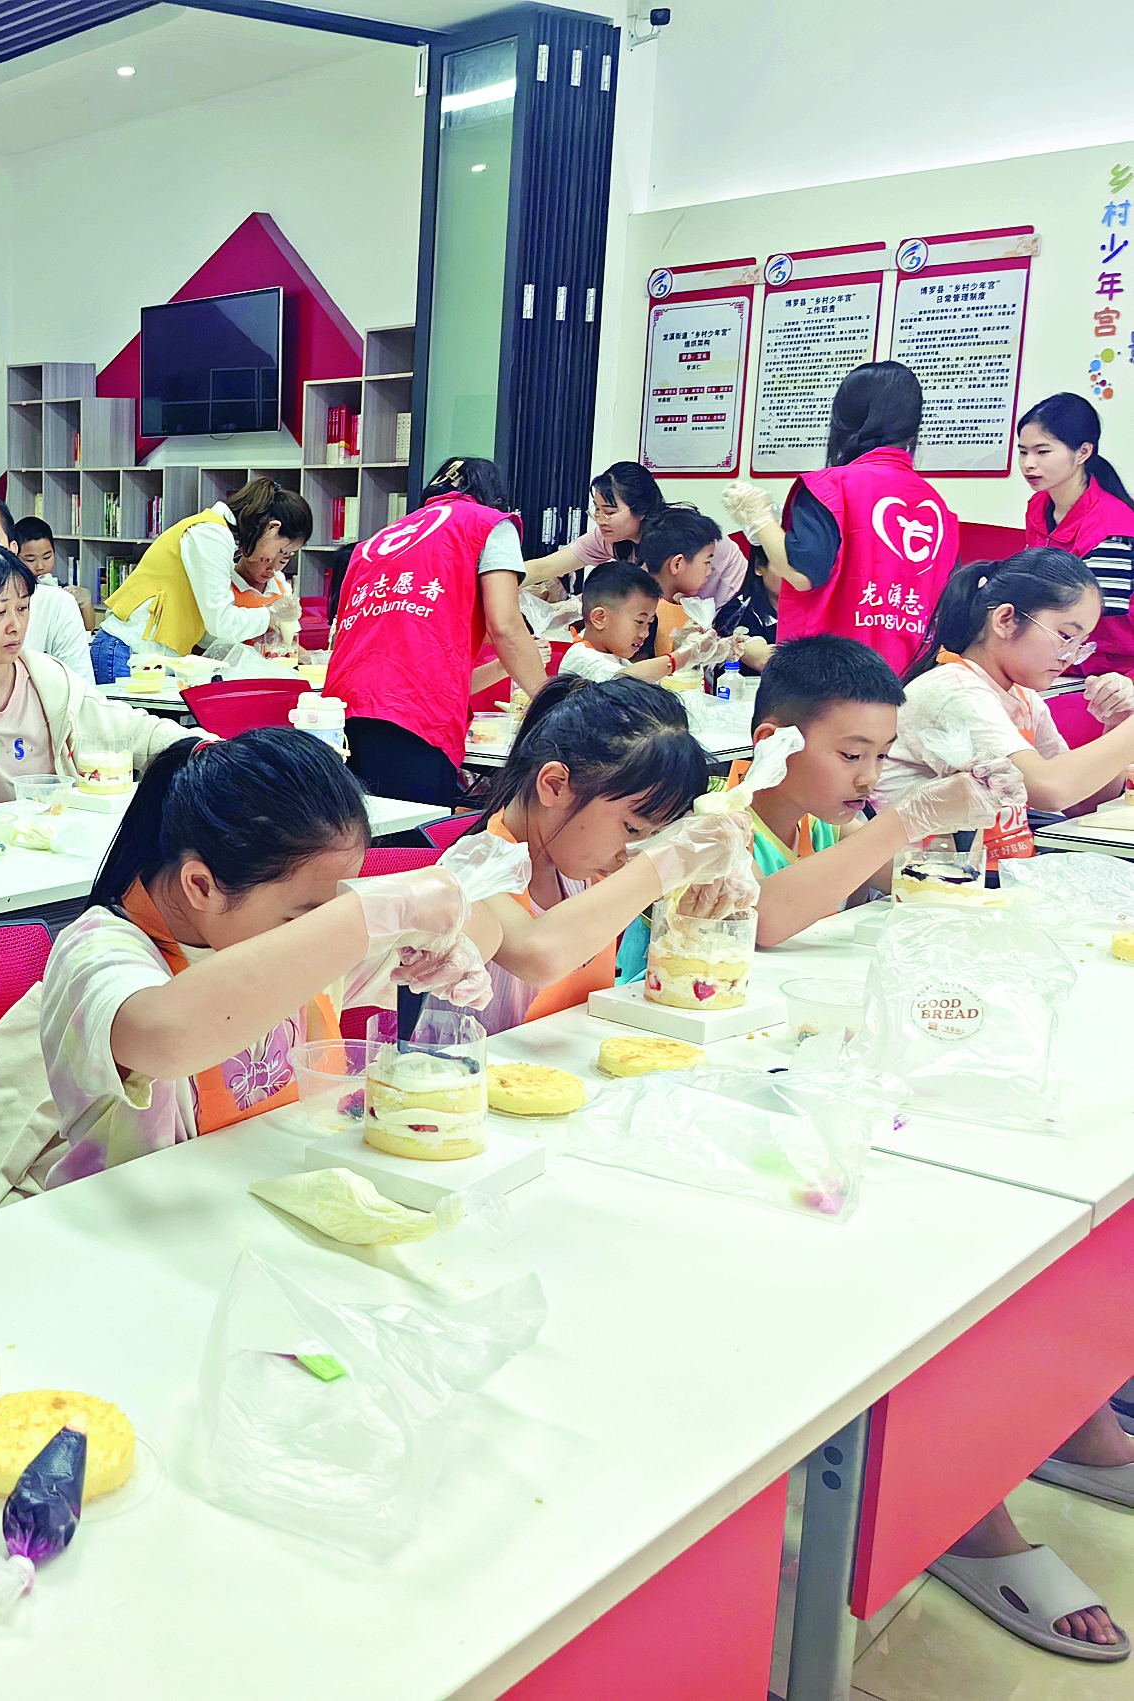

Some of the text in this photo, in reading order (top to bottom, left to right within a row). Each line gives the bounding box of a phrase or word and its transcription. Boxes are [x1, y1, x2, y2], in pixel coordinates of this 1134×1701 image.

[1094, 164, 1133, 337] 乡村少年宫
[937, 292, 986, 303] 日常管理制度
[806, 305, 835, 315] 工作职责
[345, 572, 445, 611] 溪志愿者
[362, 599, 434, 618] Volunteer
[917, 998, 962, 1009] GOOD
[921, 1008, 979, 1020] BREAD
